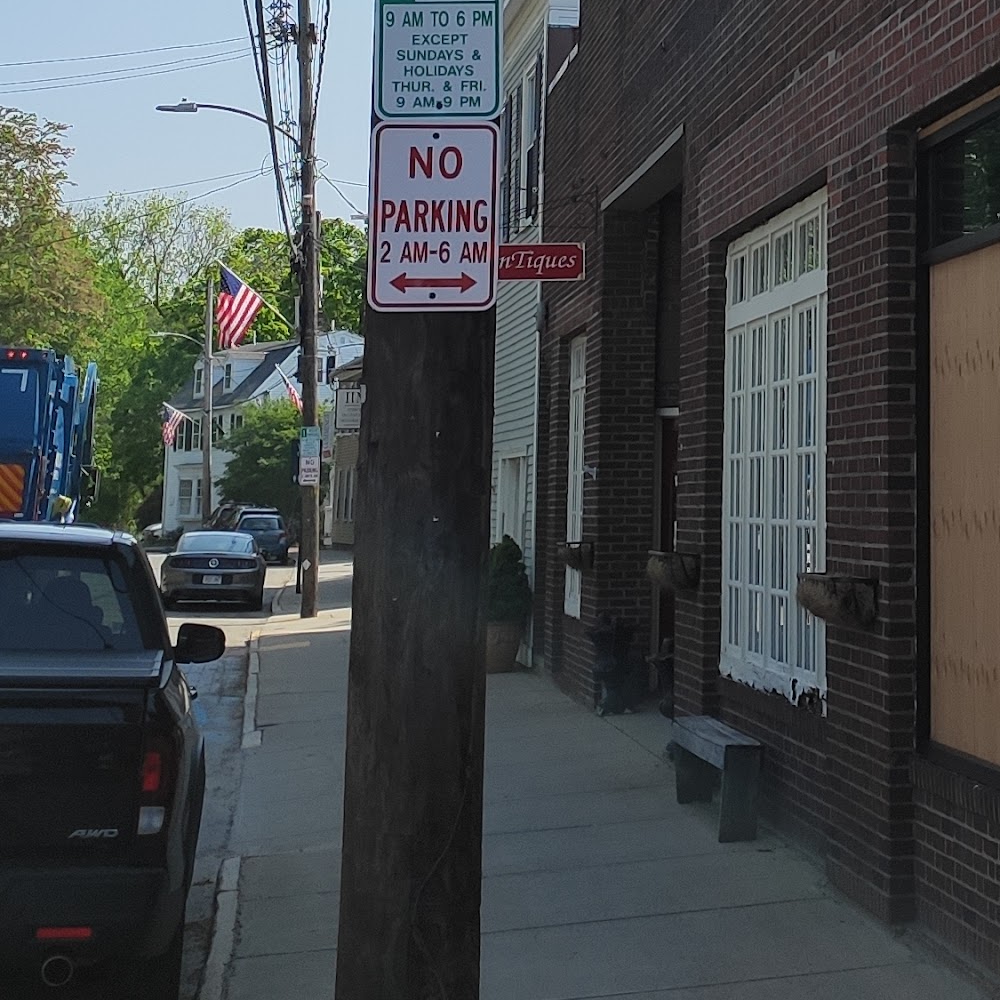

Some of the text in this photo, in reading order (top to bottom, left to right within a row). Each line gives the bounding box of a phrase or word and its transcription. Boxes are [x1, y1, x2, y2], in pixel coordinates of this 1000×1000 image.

[385, 10, 493, 28] 9 AM TO 6 PM
[411, 33, 469, 46] EXCEPT
[396, 49, 482, 61] SUNDAYS &
[403, 65, 475, 77] HOLIDAYS
[391, 80, 487, 93] THUR. & FRI.
[396, 96, 406, 108] 9
[460, 96, 481, 108] PM
[408, 146, 463, 179] NO
[380, 200, 488, 233] PARKING
[380, 241, 391, 263] 2
[459, 241, 488, 263] AM
[68, 829, 119, 839] AWD
